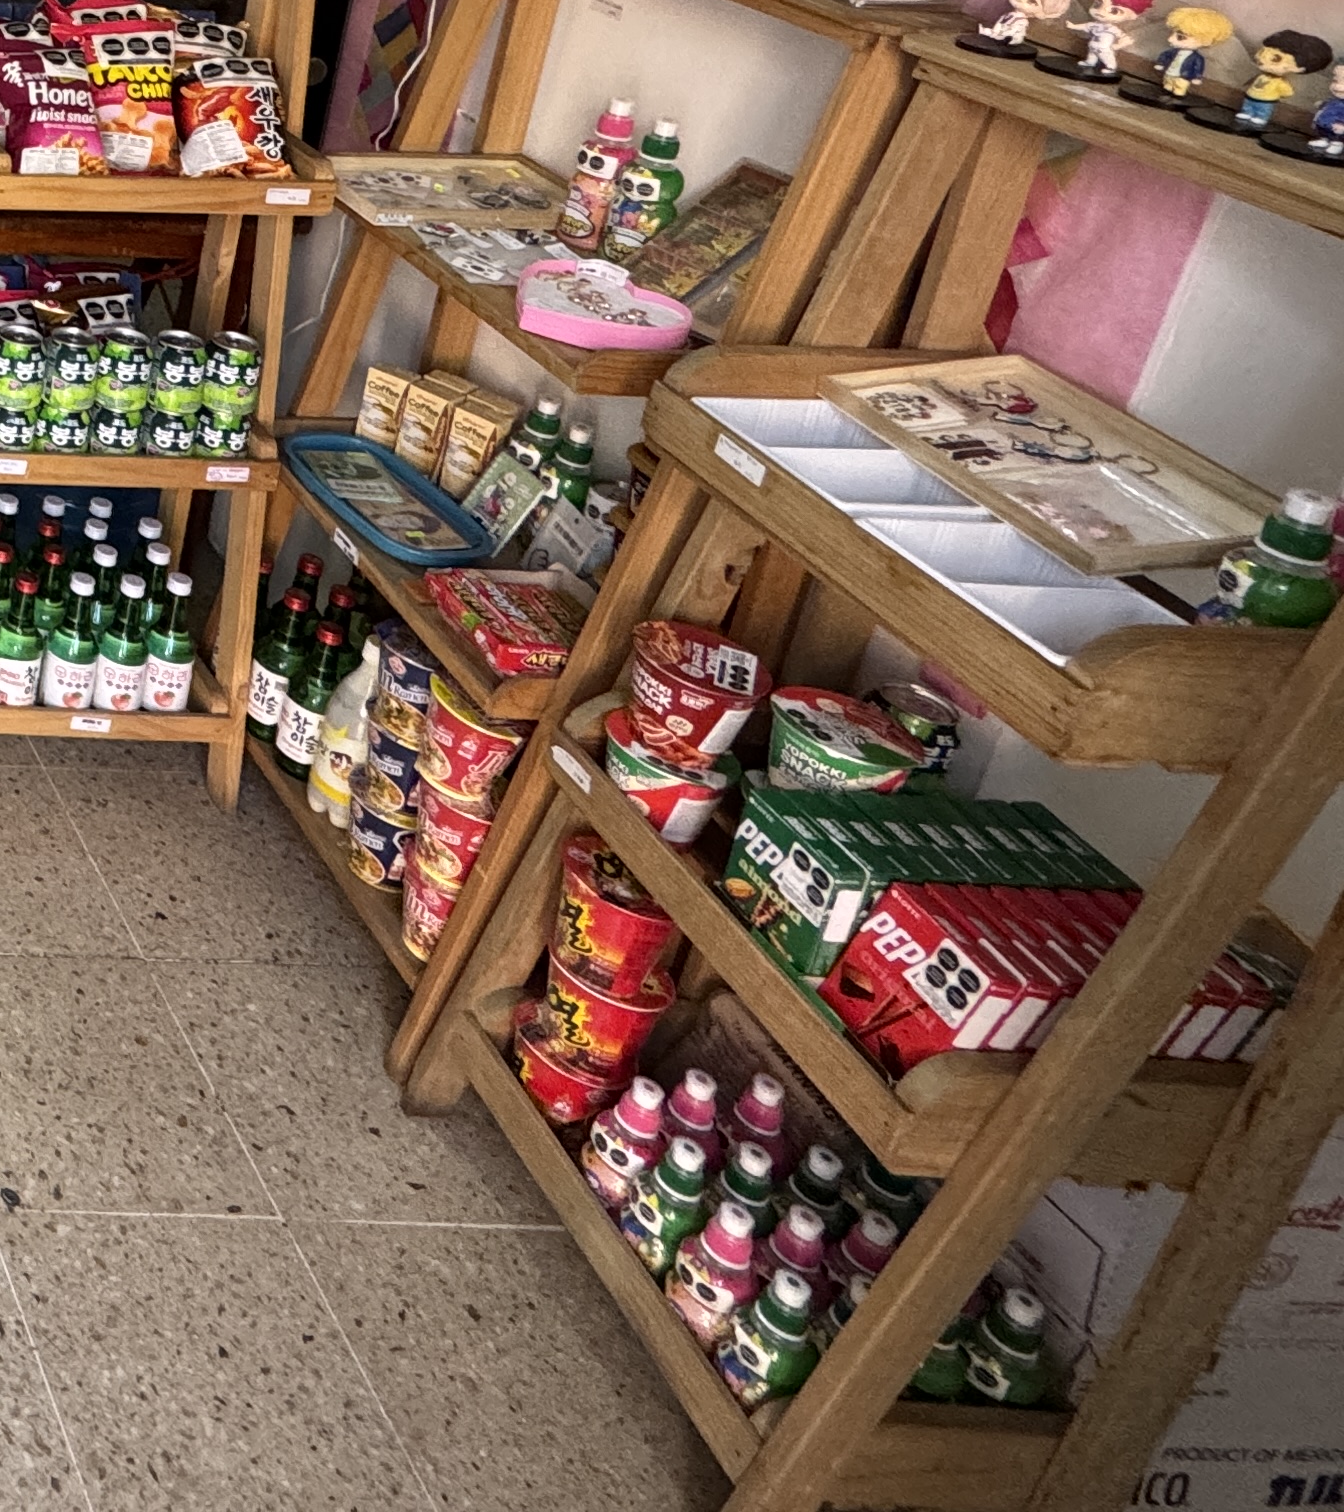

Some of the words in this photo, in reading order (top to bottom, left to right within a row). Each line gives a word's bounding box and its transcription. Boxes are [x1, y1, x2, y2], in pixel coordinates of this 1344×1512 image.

[27, 81, 95, 114] Honey
[367, 380, 401, 399] Coffee
[407, 398, 440, 418] Coffee
[454, 421, 488, 442] Coffee
[783, 738, 847, 780] YOPOKKI
[734, 817, 785, 867] PEP
[859, 911, 927, 966] PEP
